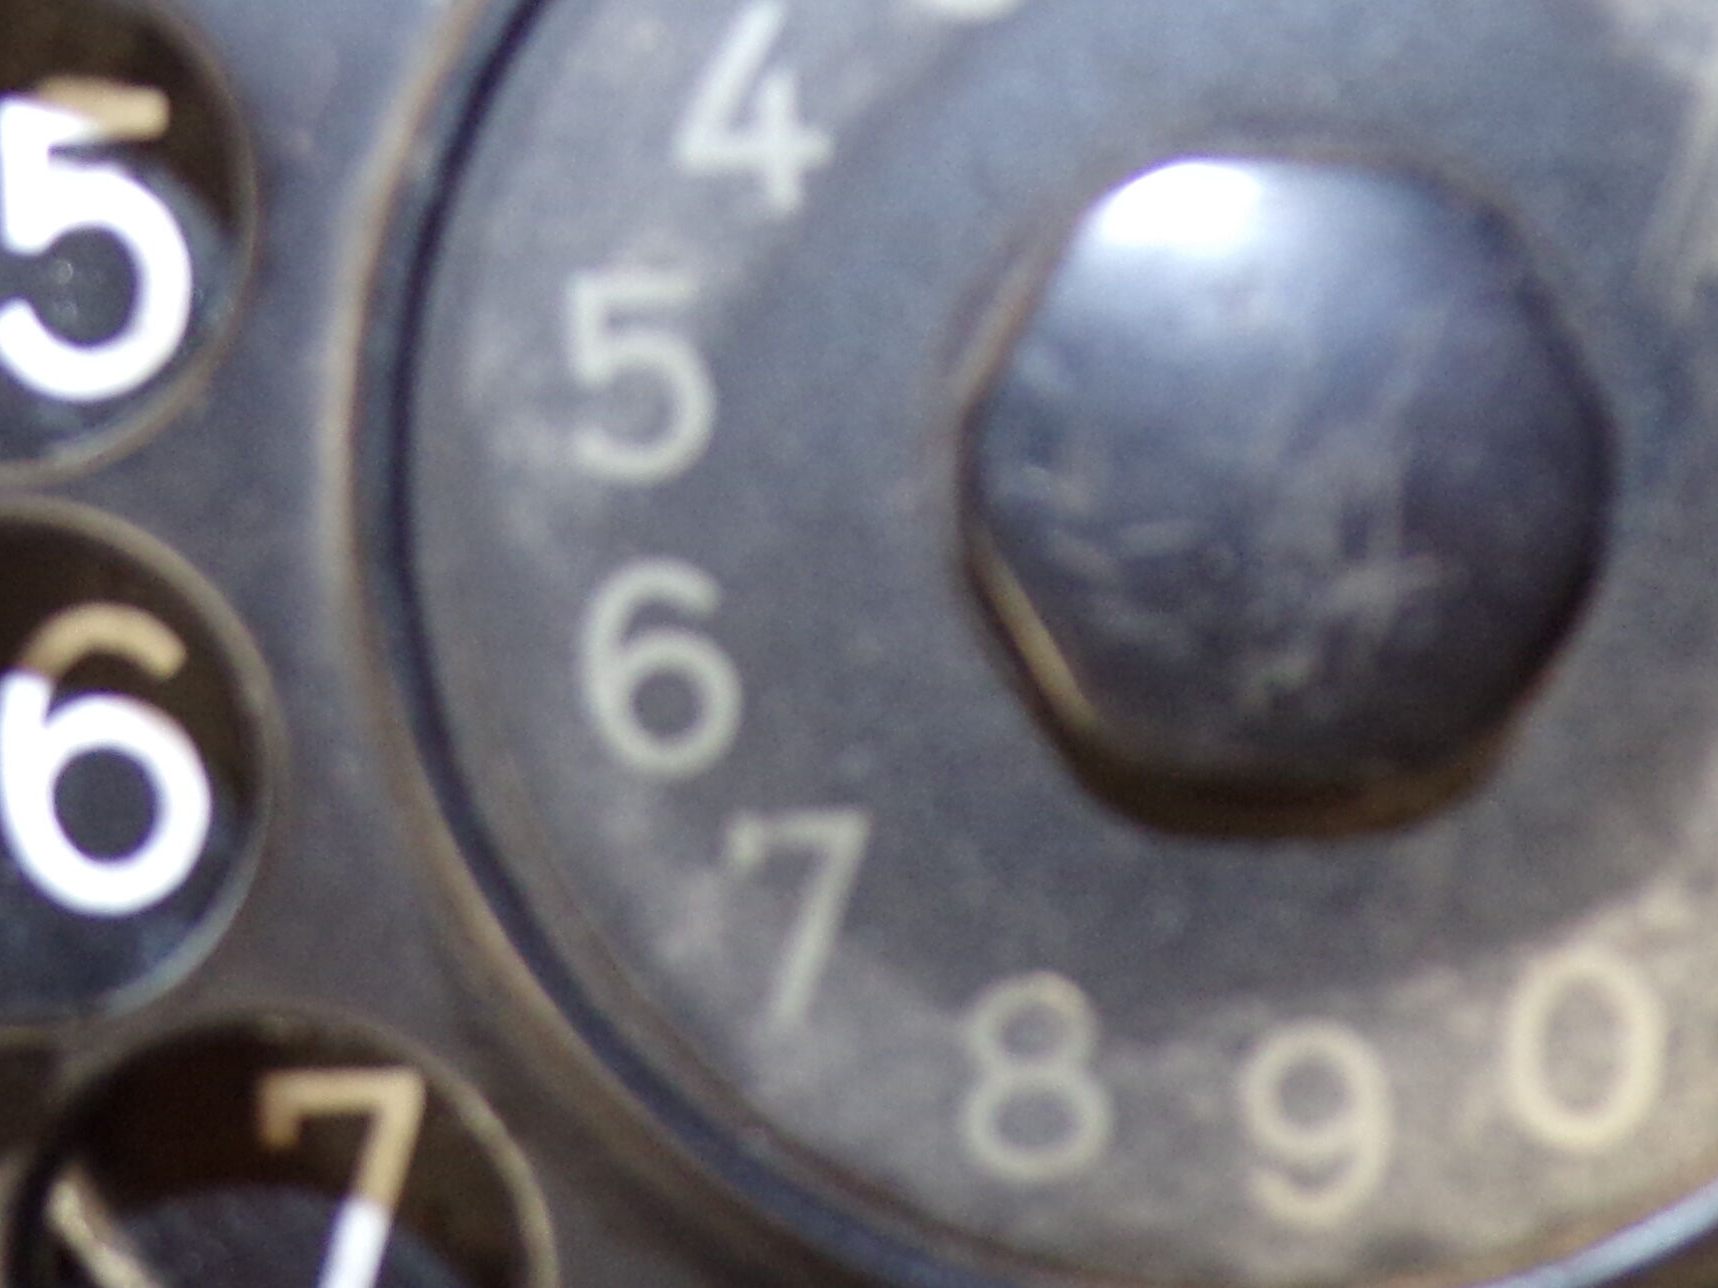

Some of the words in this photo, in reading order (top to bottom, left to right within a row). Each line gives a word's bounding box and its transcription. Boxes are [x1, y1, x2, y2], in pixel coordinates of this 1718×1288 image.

[562, 267, 716, 486] 5
[581, 556, 742, 774] 6
[727, 806, 871, 1032] 7
[962, 969, 1113, 1185] 8
[1238, 1019, 1391, 1219] 9
[1501, 941, 1660, 1155] 0
